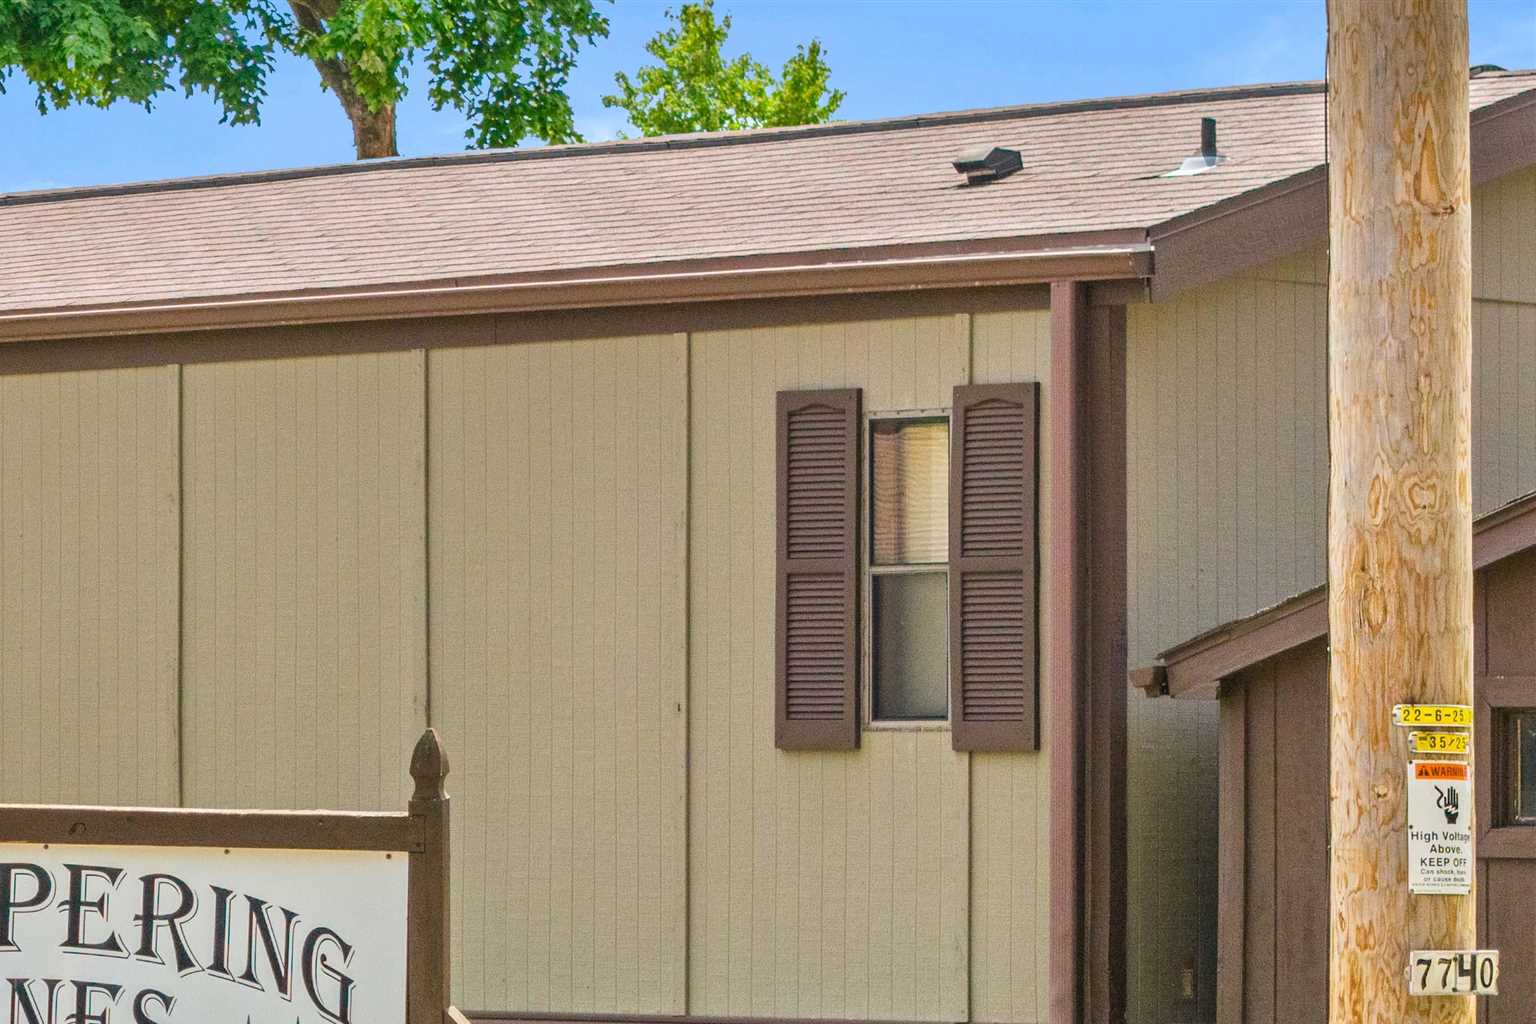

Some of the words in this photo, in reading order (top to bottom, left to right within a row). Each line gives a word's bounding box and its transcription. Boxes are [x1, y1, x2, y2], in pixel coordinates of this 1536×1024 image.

[1410, 831, 1438, 843] High
[1442, 831, 1470, 844] Voltag
[1420, 857, 1450, 867] KEEP
[1453, 857, 1467, 867] OFF
[1416, 953, 1494, 991] 7740
